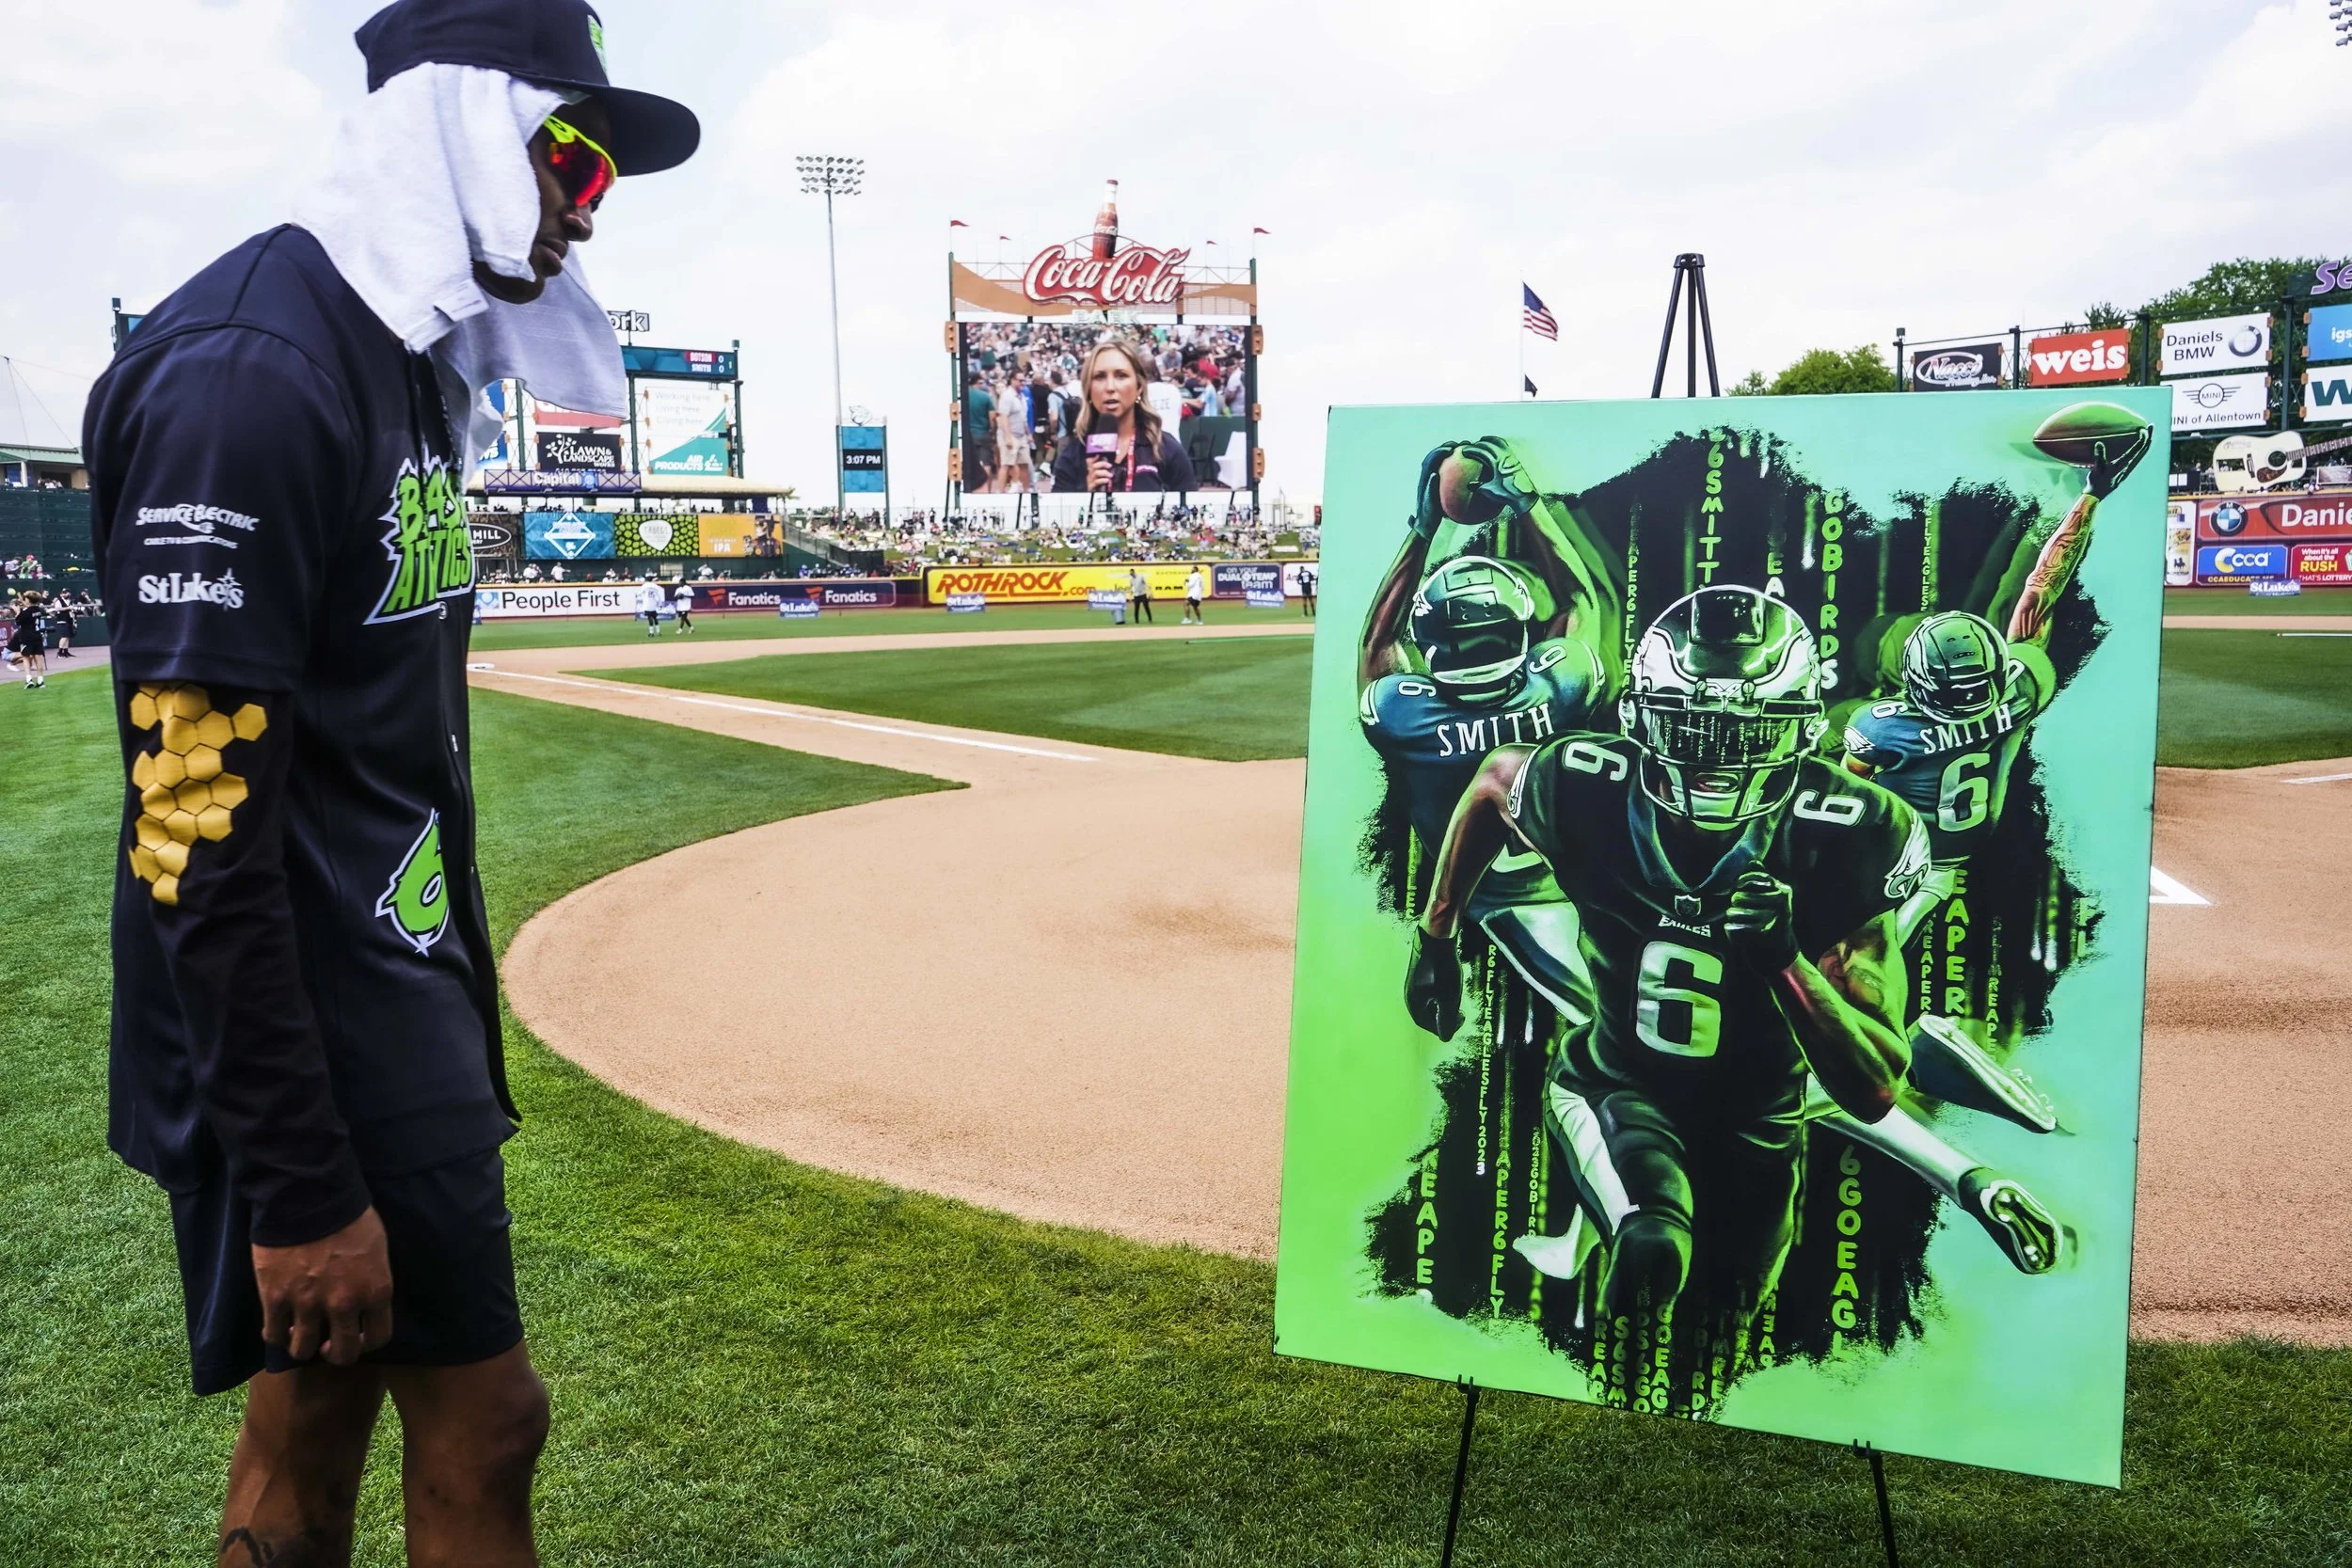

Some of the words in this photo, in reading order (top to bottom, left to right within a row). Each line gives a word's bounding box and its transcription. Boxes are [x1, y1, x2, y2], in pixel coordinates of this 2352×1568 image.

[1025, 246, 1190, 304] Coca-Cola
[1073, 309, 1142, 324] PARK
[2167, 331, 2223, 347] Daniels
[2032, 340, 2125, 375] weis
[2174, 346, 2215, 361] BMW
[2192, 414, 2202, 422] of
[2205, 412, 2261, 422] Allentown
[569, 447, 606, 456] LAWN
[655, 461, 702, 470] PRODUCTS
[846, 455, 865, 464] 3:07
[866, 455, 881, 464] PM
[533, 472, 580, 486] Capital
[713, 544, 731, 553] IPA
[2300, 562, 2338, 572] RUSH
[825, 590, 878, 604] Fanatics
[1821, 489, 1844, 690] GOBIRDS
[502, 591, 571, 612] People
[578, 590, 620, 608] First
[728, 593, 781, 607] Fanatics
[1437, 702, 1555, 758] SMITH
[1919, 703, 2013, 755] SMITH
[1938, 752, 1991, 832] 6
[1635, 941, 1724, 1058] 6
